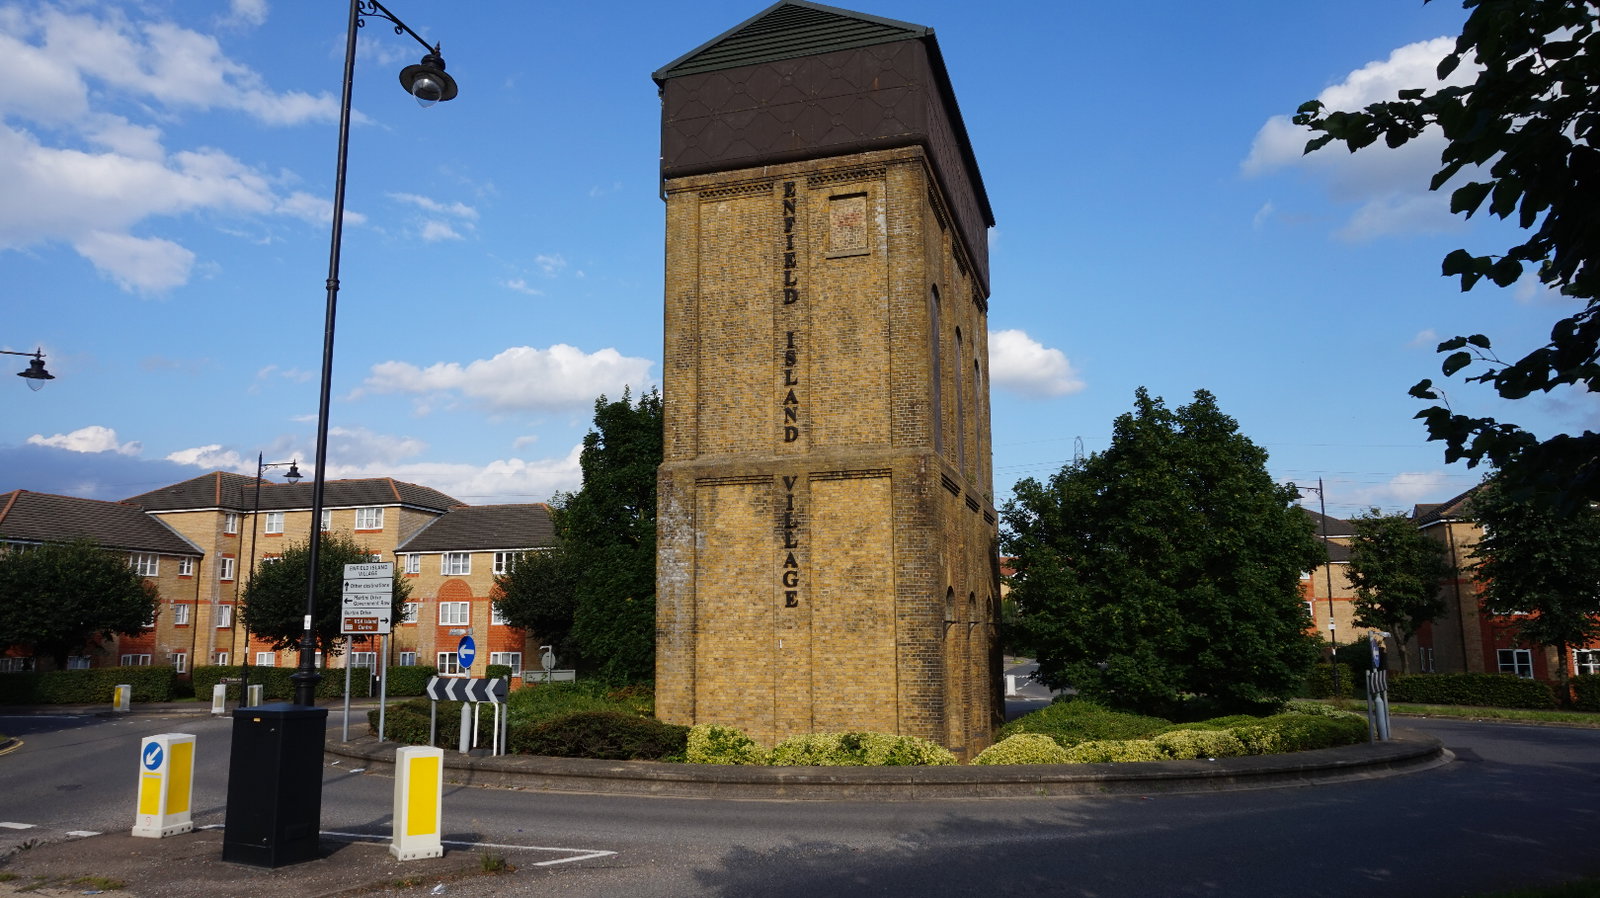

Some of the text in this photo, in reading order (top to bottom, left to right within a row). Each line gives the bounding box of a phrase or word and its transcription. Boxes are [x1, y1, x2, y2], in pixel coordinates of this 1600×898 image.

[783, 181, 799, 608] ENFIELD ISLAND VILLAGE
